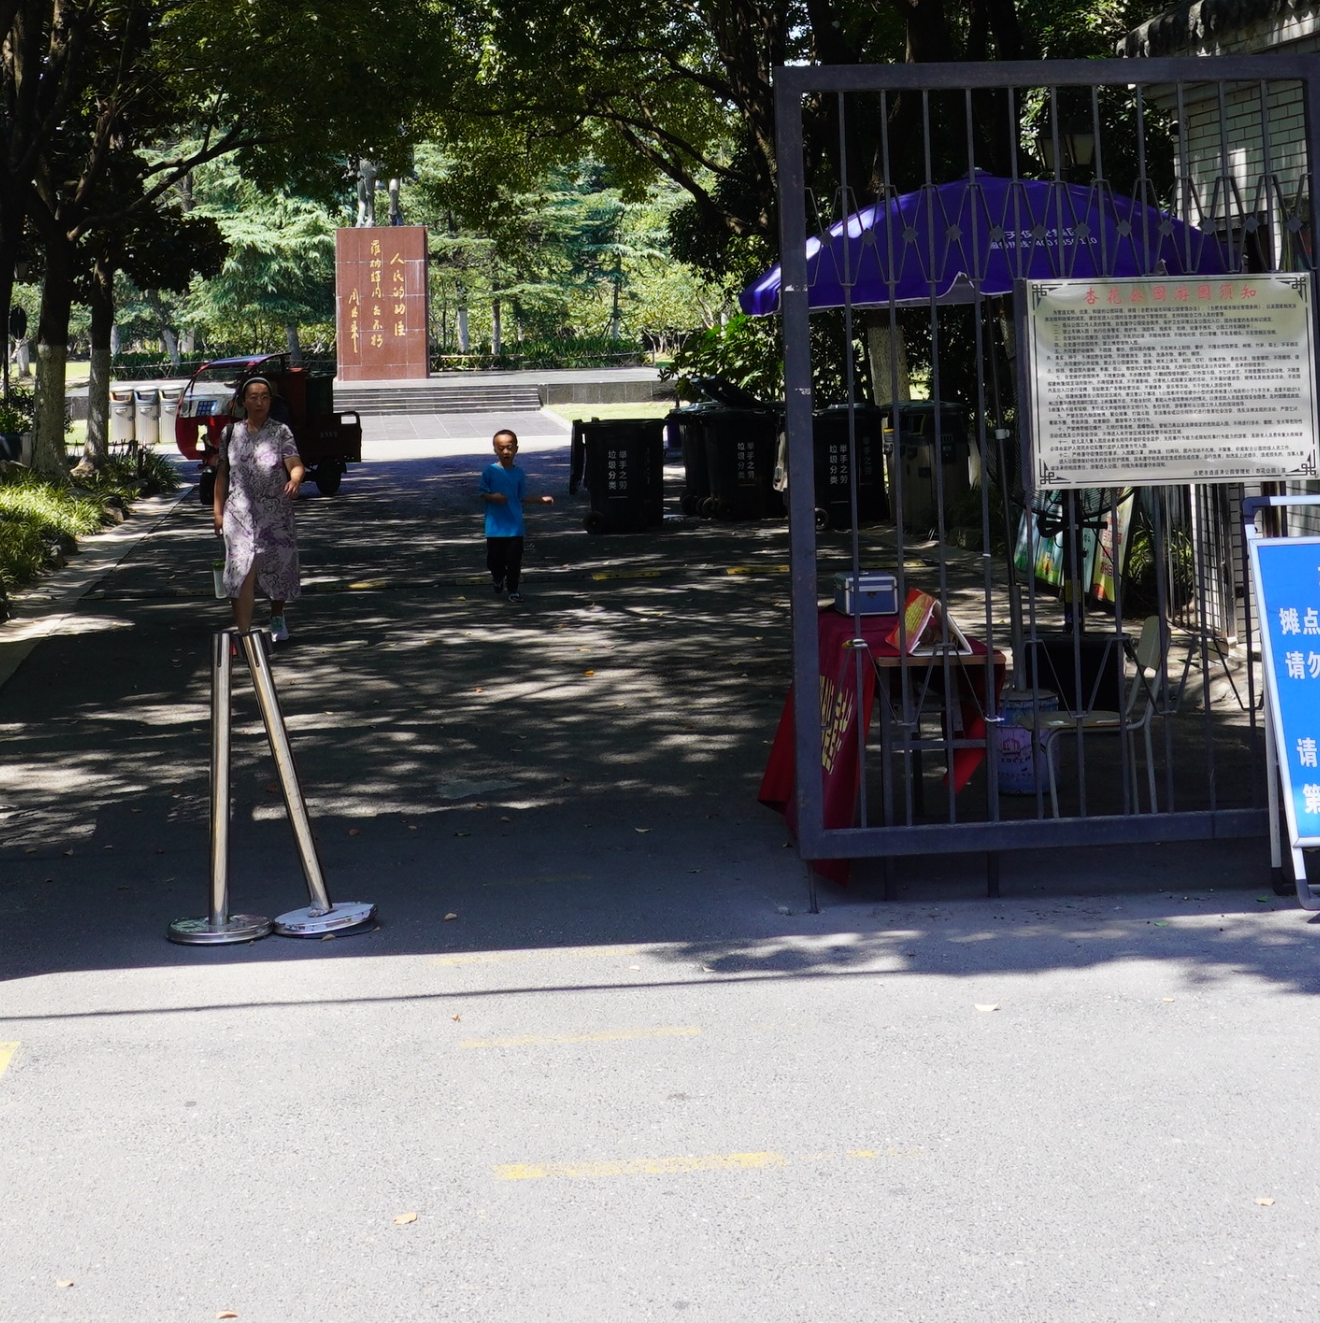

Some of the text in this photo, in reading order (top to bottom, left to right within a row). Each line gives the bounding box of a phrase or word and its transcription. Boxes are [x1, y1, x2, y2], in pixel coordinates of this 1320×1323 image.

[1083, 284, 1258, 305] 杏花公园游园须知
[607, 450, 617, 490] 垃圾分类
[619, 450, 628, 490] 举手之劳
[829, 444, 838, 485] 垃圾分类
[839, 444, 849, 484] 举手之劳
